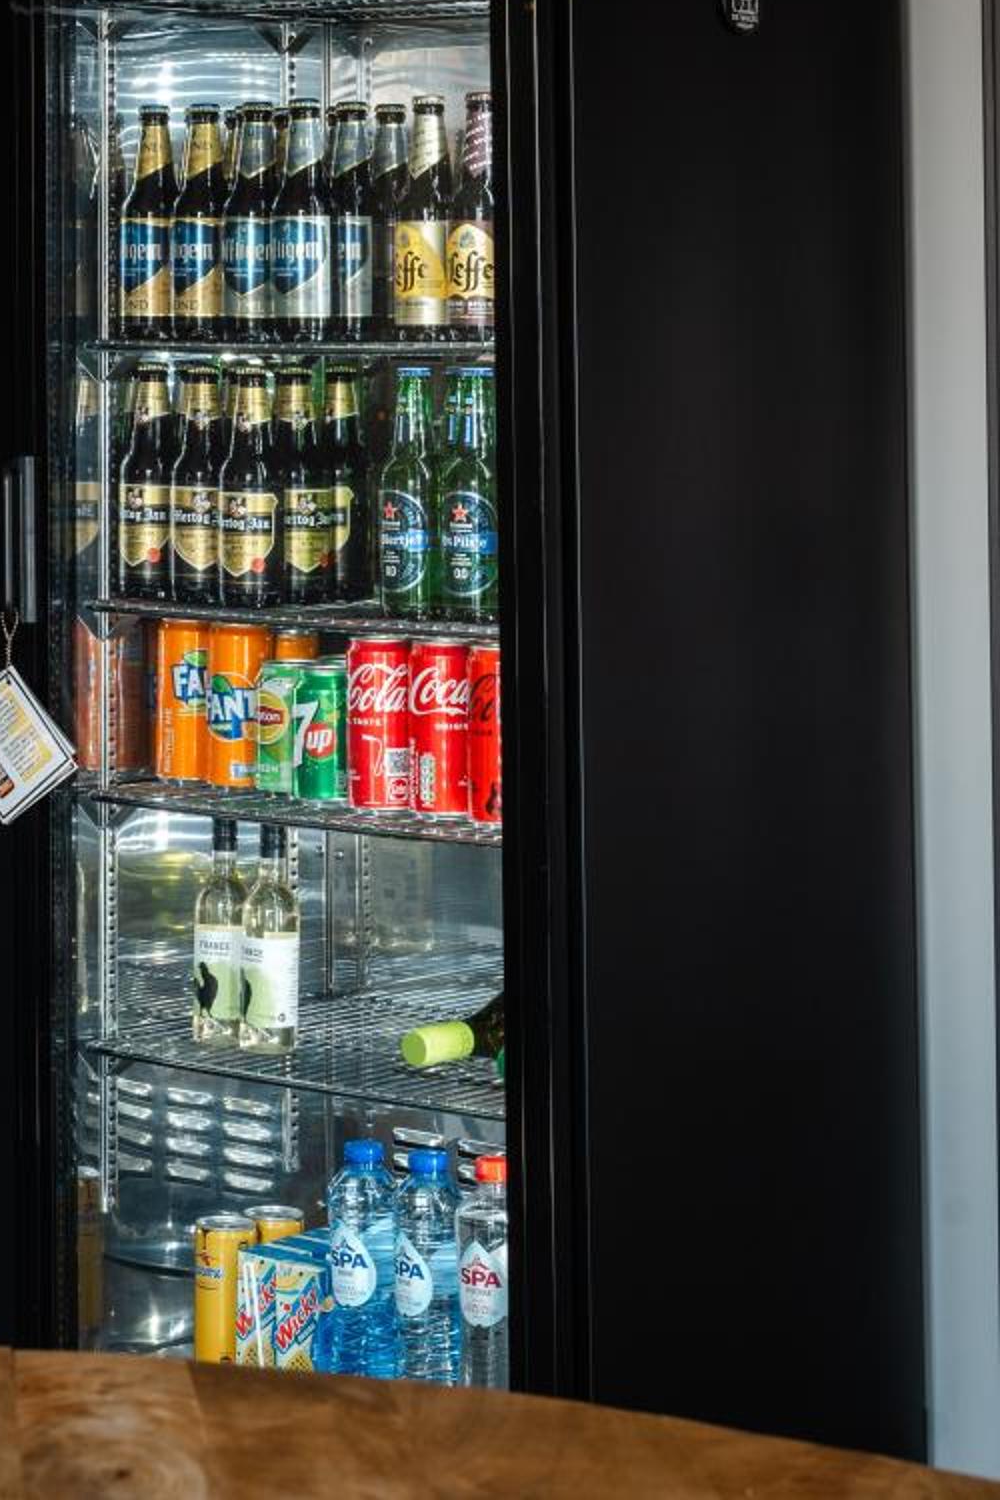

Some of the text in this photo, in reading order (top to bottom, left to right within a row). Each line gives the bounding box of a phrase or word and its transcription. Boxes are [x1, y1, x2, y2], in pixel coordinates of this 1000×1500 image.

[306, 730, 333, 753] up
[331, 1249, 369, 1269] SPA
[460, 1267, 502, 1289] SPA
